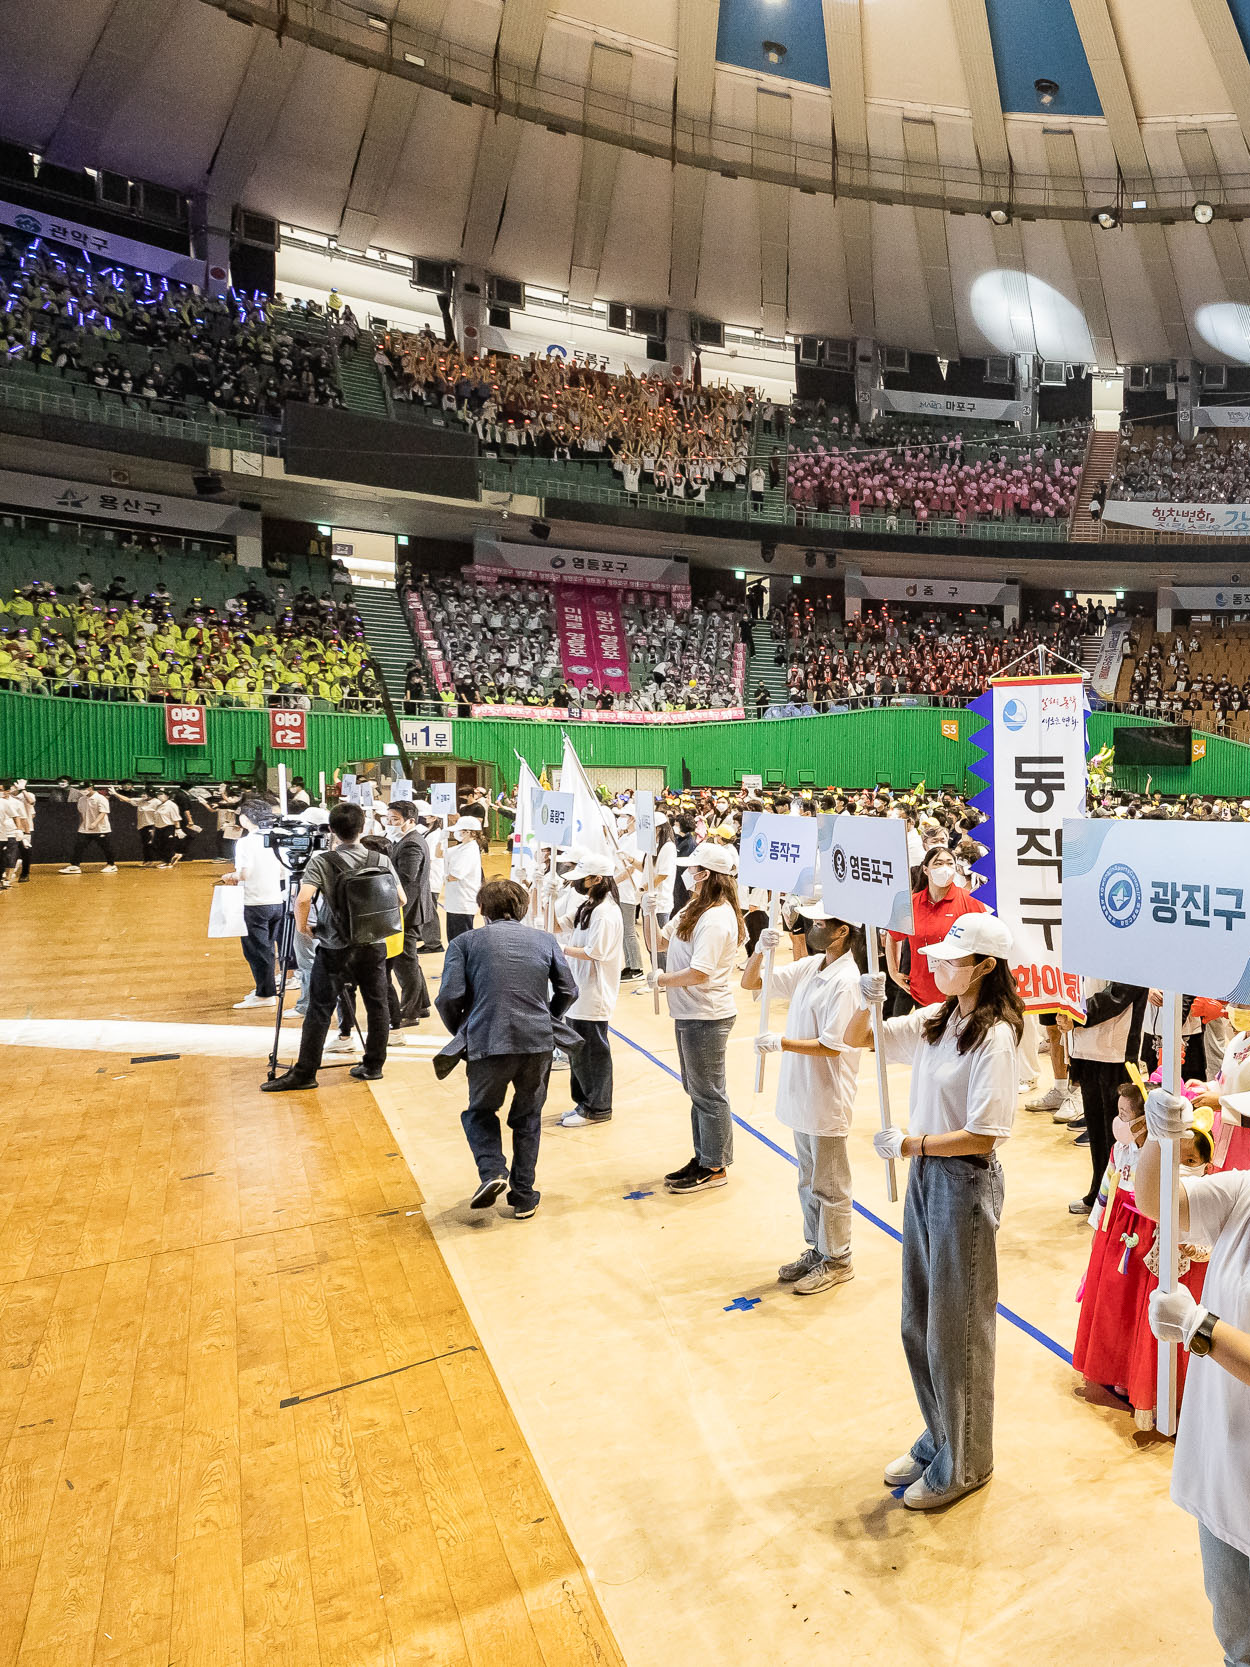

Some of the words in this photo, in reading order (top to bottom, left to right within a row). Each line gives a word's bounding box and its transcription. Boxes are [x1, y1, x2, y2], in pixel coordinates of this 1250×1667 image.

[48, 224, 109, 251] 관악구
[945, 401, 977, 412] 마포구
[98, 493, 162, 517] 용산구
[572, 557, 629, 574] 영등포구
[170, 707, 201, 740] 용산
[274, 712, 302, 745] 용산
[943, 724, 957, 734] S3
[1192, 744, 1206, 755] S4
[769, 840, 801, 864] 동작구
[1014, 756, 1065, 952] 동작구
[849, 855, 894, 886] 영등포구
[1149, 881, 1246, 932] 광진구
